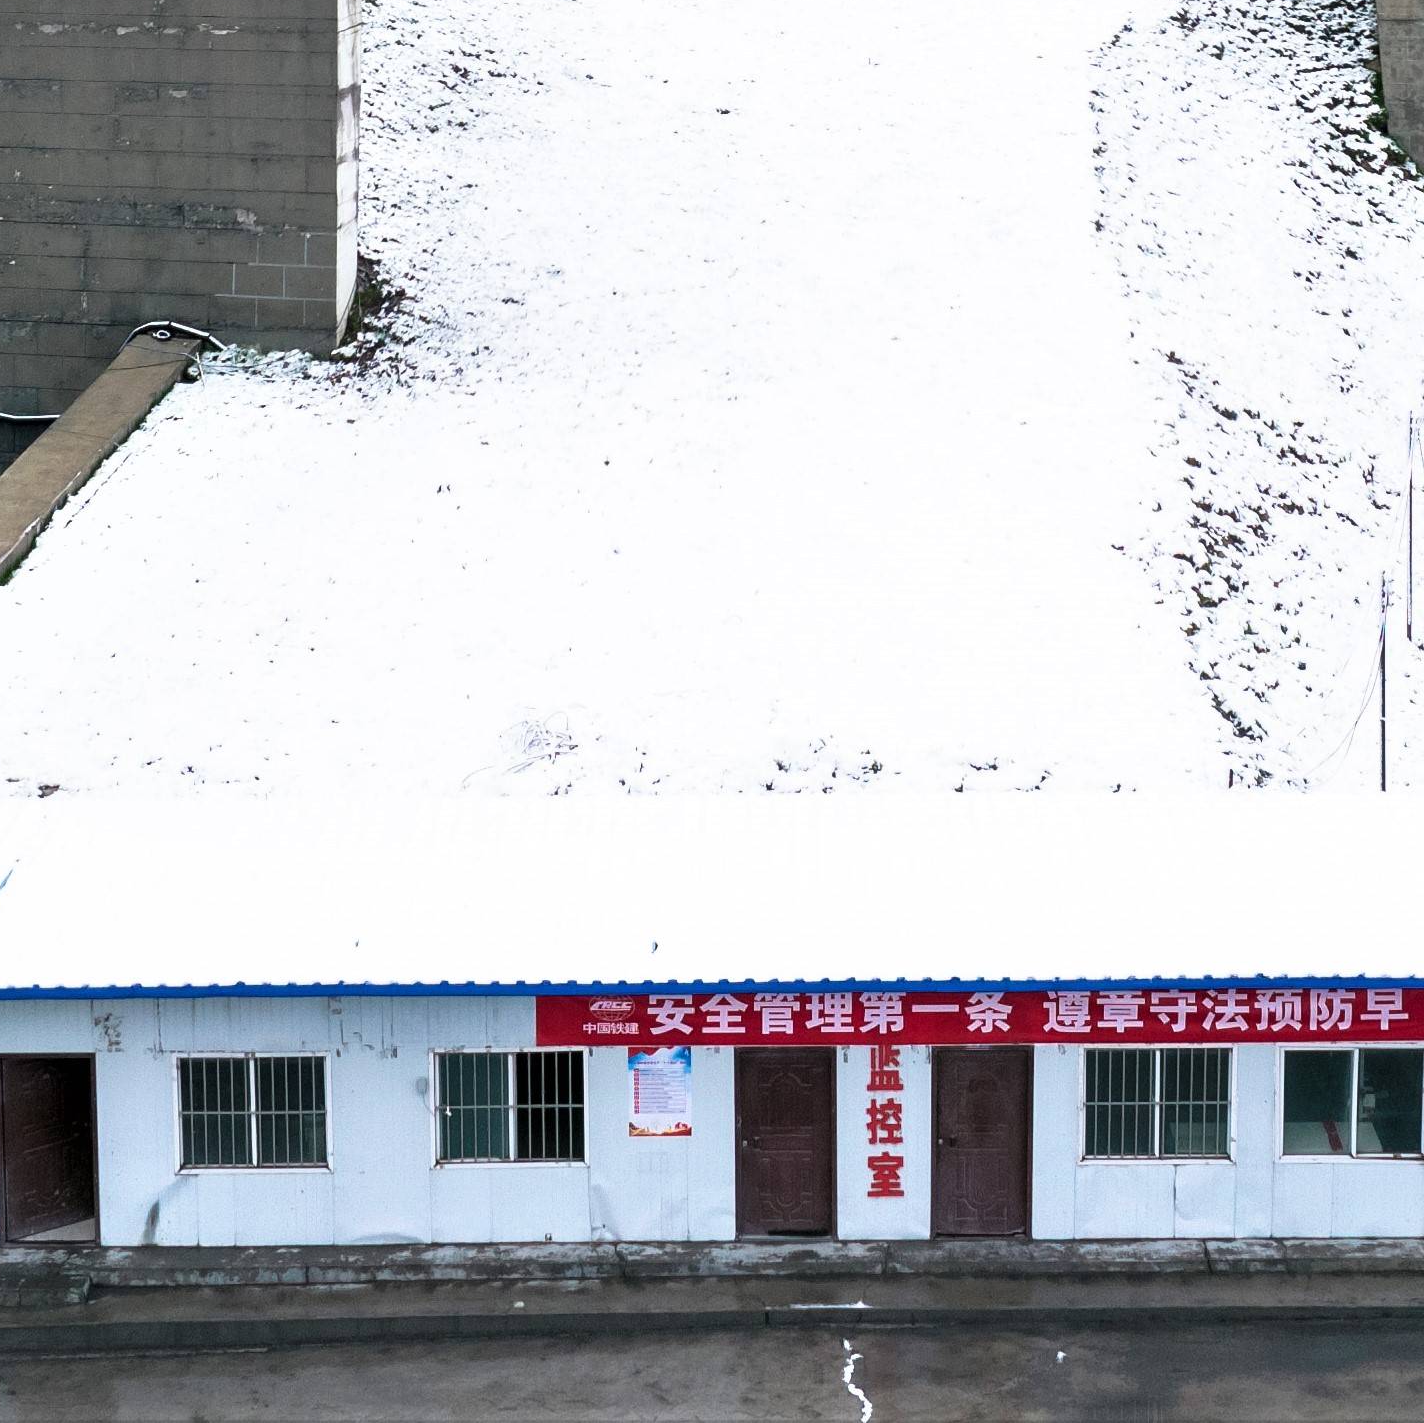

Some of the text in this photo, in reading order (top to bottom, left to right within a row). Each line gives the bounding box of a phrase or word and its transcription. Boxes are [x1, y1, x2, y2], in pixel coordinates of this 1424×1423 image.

[582, 1022, 640, 1035] 中国铁建
[647, 988, 1410, 1036] 安全管理第一条 遵章守法预防早
[866, 1044, 905, 1198] 监控室
